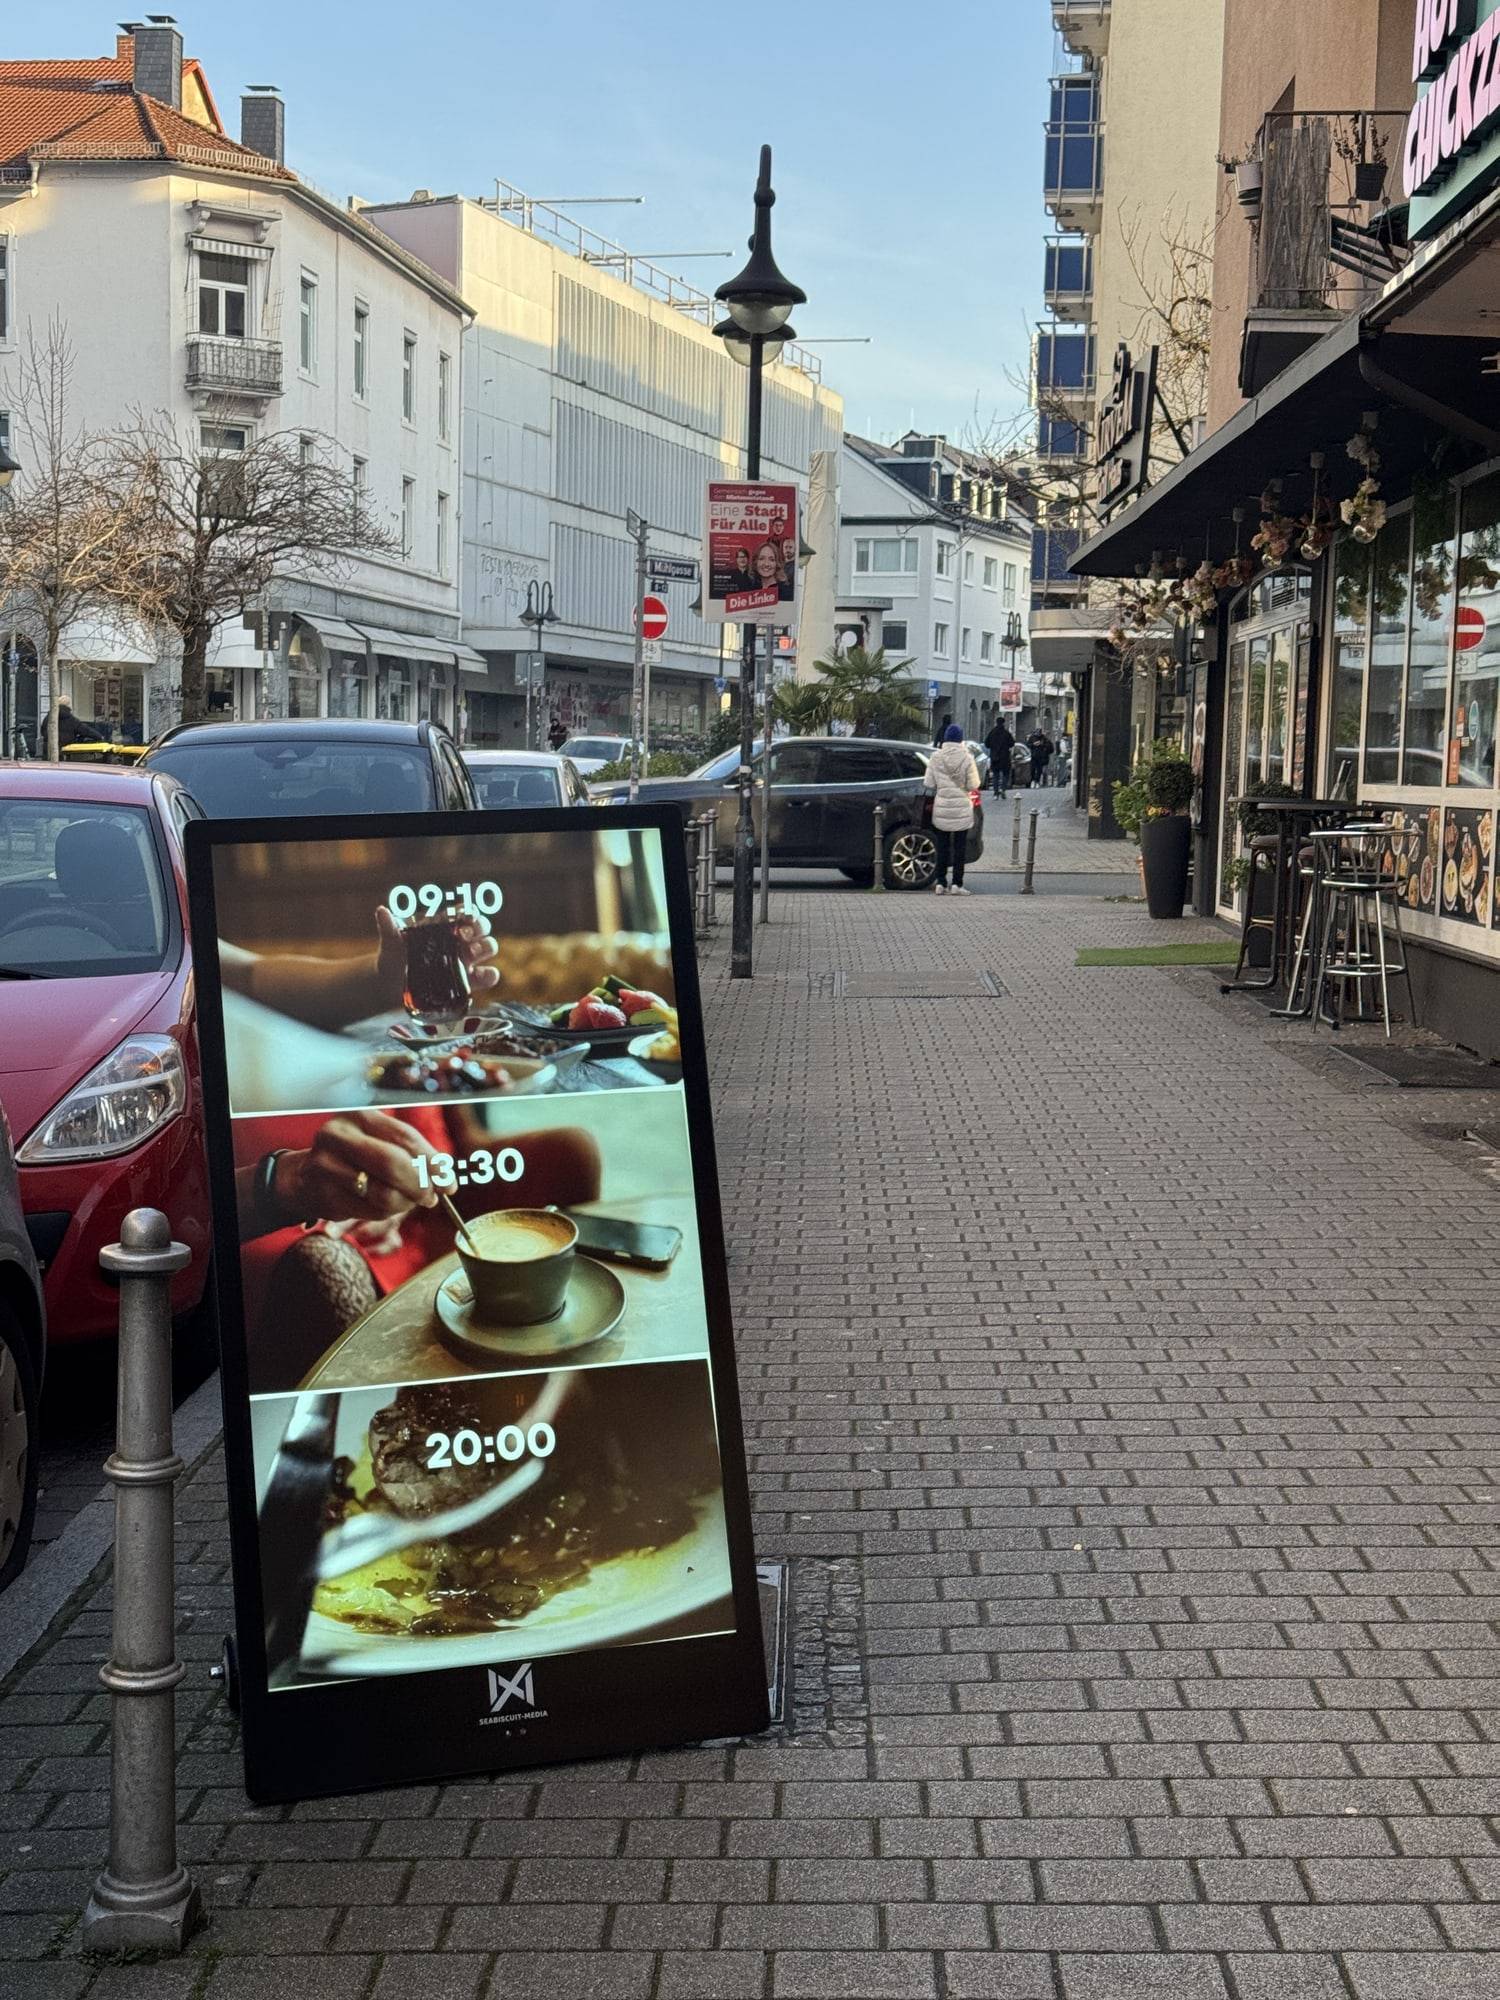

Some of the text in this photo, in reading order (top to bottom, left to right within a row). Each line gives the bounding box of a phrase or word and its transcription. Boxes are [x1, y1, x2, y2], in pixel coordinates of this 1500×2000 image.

[711, 503, 785, 518] Eine Stadt
[711, 517, 767, 531] Für Alle
[729, 592, 776, 609] Die Linke
[388, 881, 503, 919] 09:10
[411, 1147, 525, 1189] 13:30
[425, 1422, 556, 1469] 20:00
[479, 1710, 549, 1726] SEABISCUIT-MEDIA
